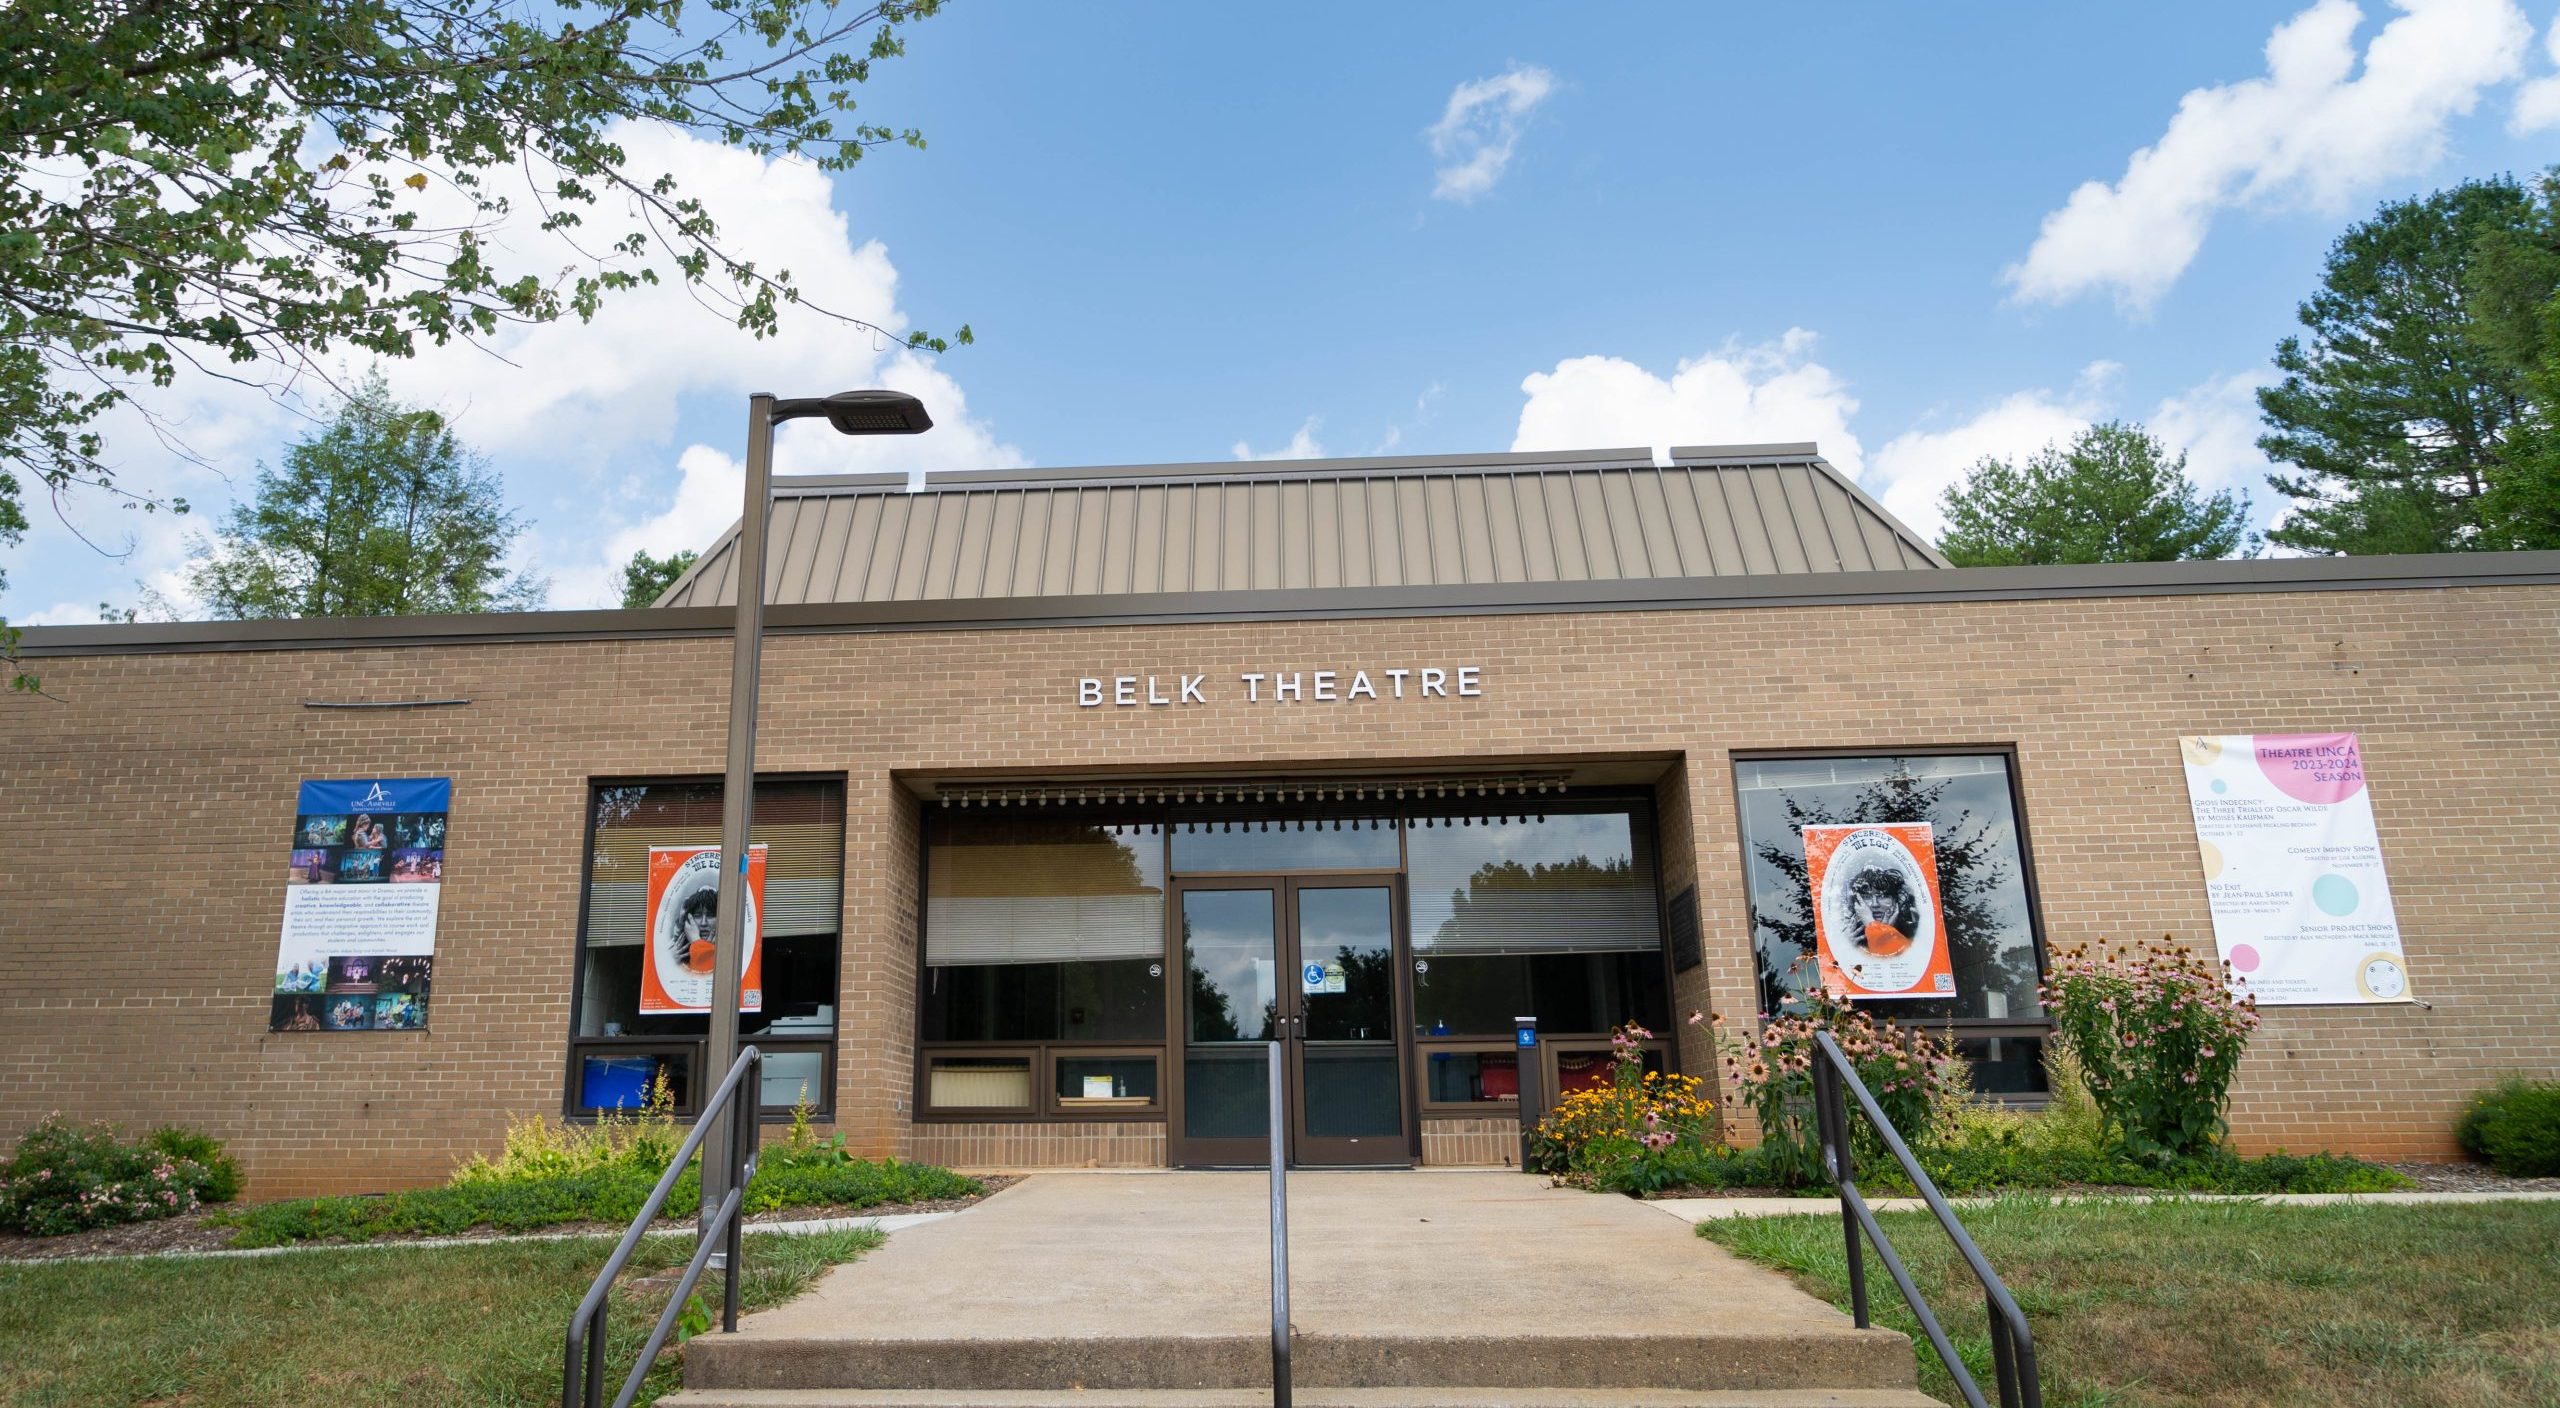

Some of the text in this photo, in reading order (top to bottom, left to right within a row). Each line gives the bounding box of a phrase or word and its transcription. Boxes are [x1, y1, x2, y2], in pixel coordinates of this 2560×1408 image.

[1079, 666, 1482, 706] BELK THEATRE
[2260, 746, 2356, 758] THEATRE UNCA
[2292, 760, 2358, 770] 2023-2024
[2314, 772, 2361, 782] SEASON
